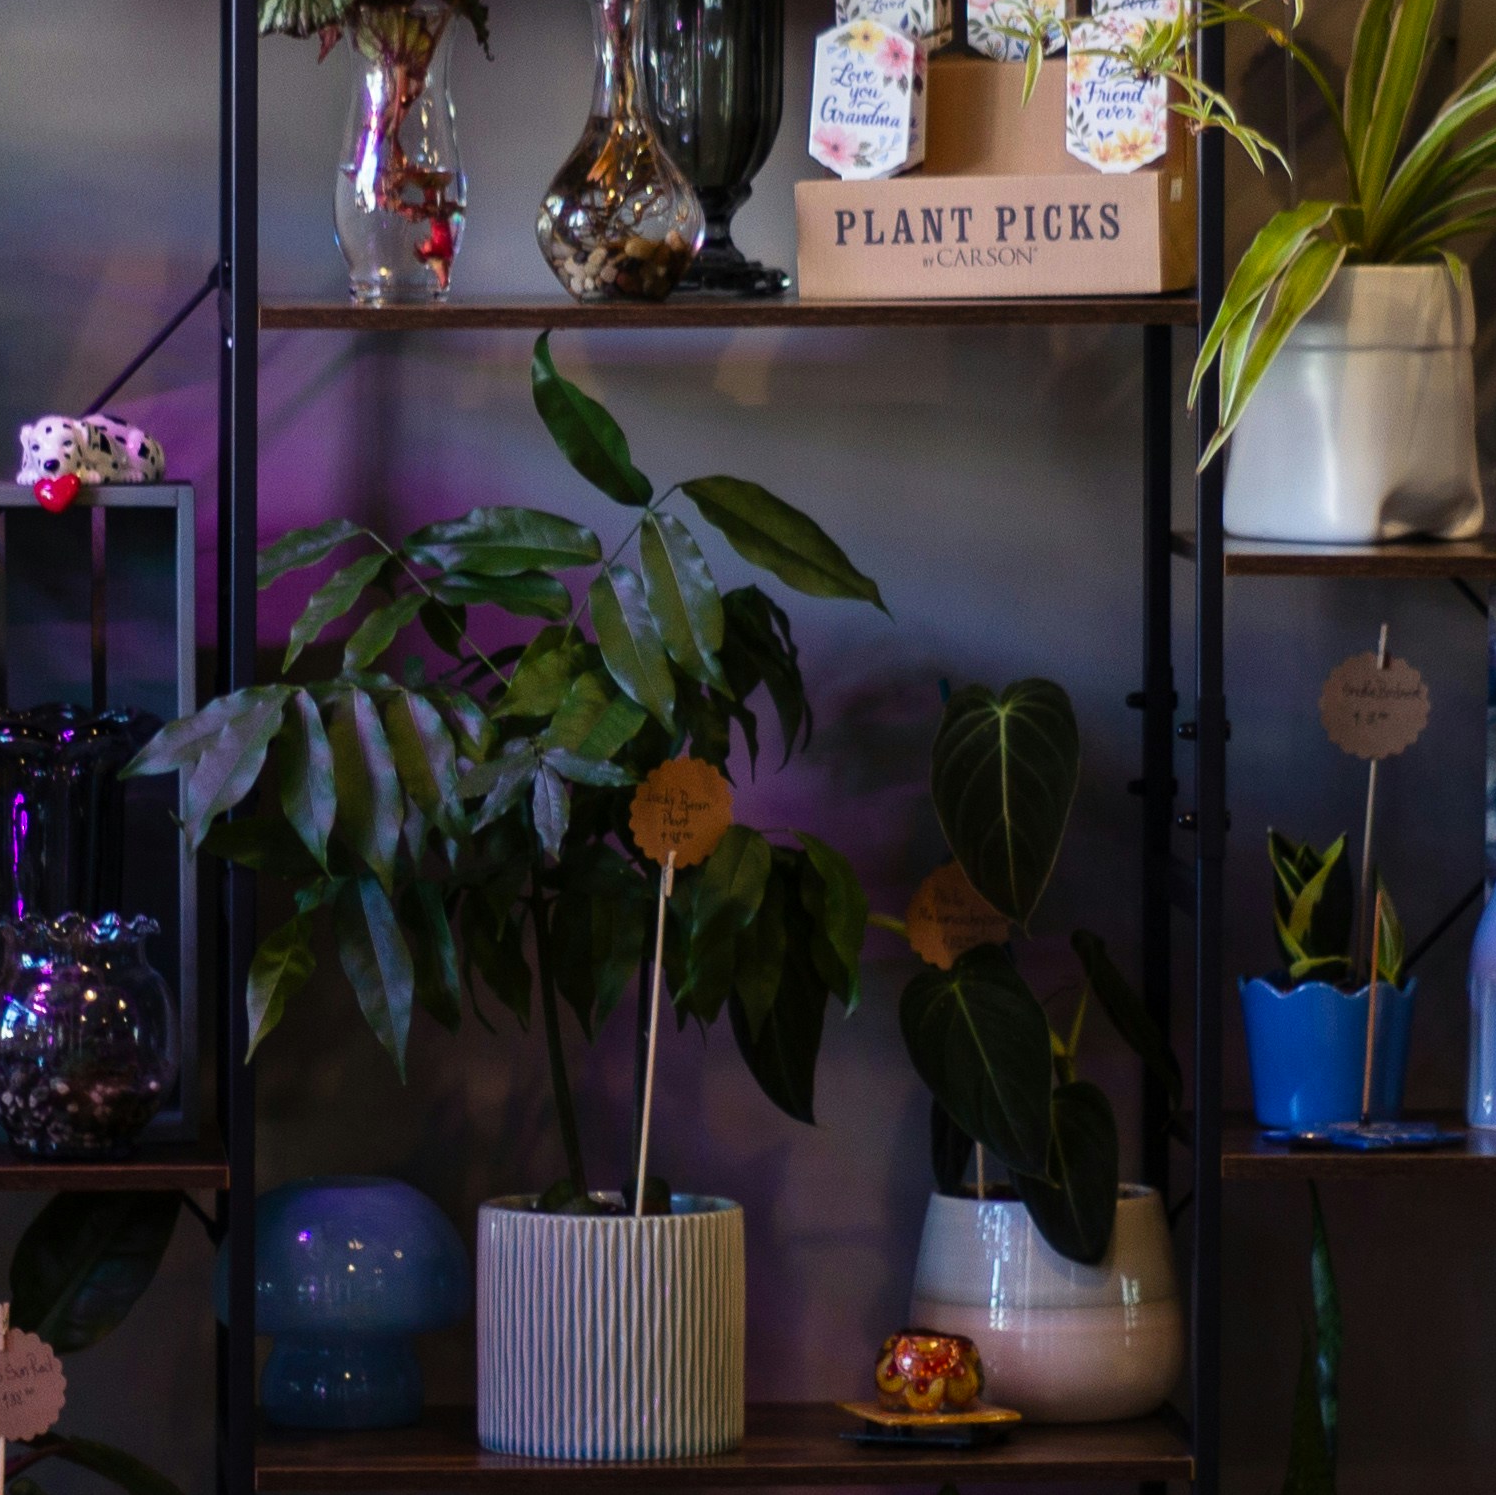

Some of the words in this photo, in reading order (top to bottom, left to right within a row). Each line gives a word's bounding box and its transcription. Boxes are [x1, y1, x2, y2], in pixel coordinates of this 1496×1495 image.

[831, 62, 878, 89] Love
[849, 82, 883, 103] you
[1085, 80, 1147, 104] Friend
[820, 99, 902, 129] Grandma
[1096, 106, 1137, 121] ever
[834, 208, 973, 246] PLANT
[995, 203, 1121, 243] PICKS
